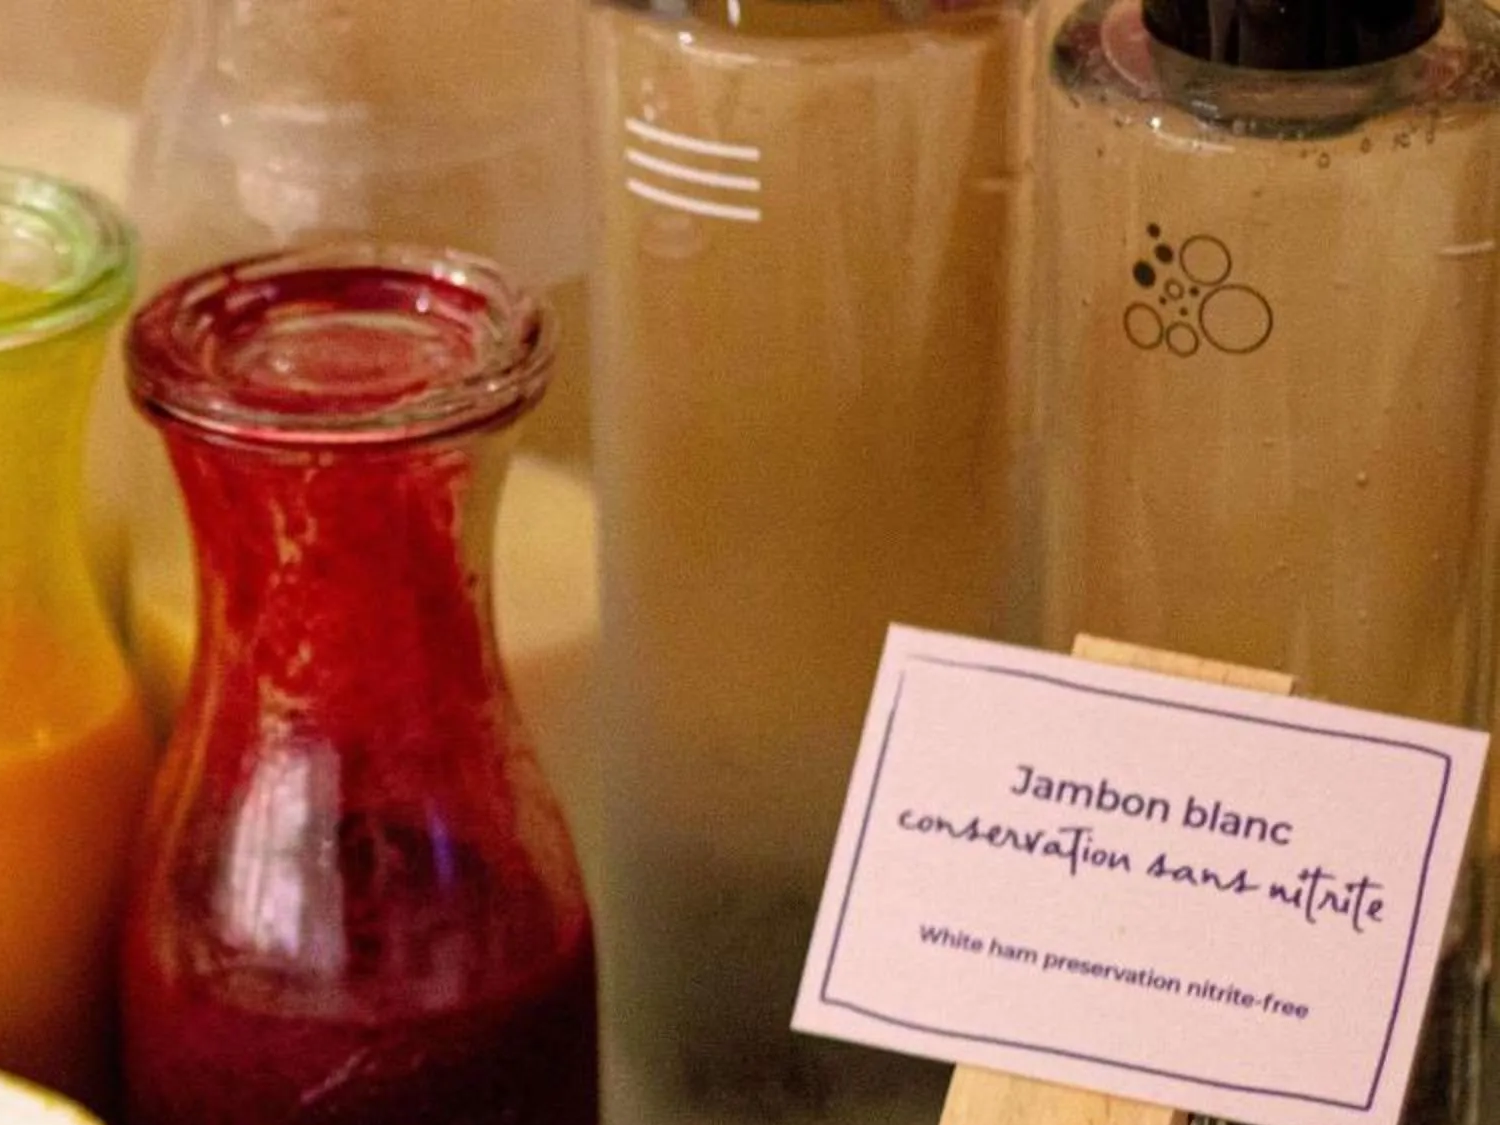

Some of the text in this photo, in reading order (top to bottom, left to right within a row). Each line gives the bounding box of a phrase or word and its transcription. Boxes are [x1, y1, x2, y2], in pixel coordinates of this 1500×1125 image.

[1011, 765, 1293, 845] Jambon blanc
[897, 807, 1384, 932] conservation sans nitrite
[919, 924, 1310, 1020] White ham preservation nitrite-free
